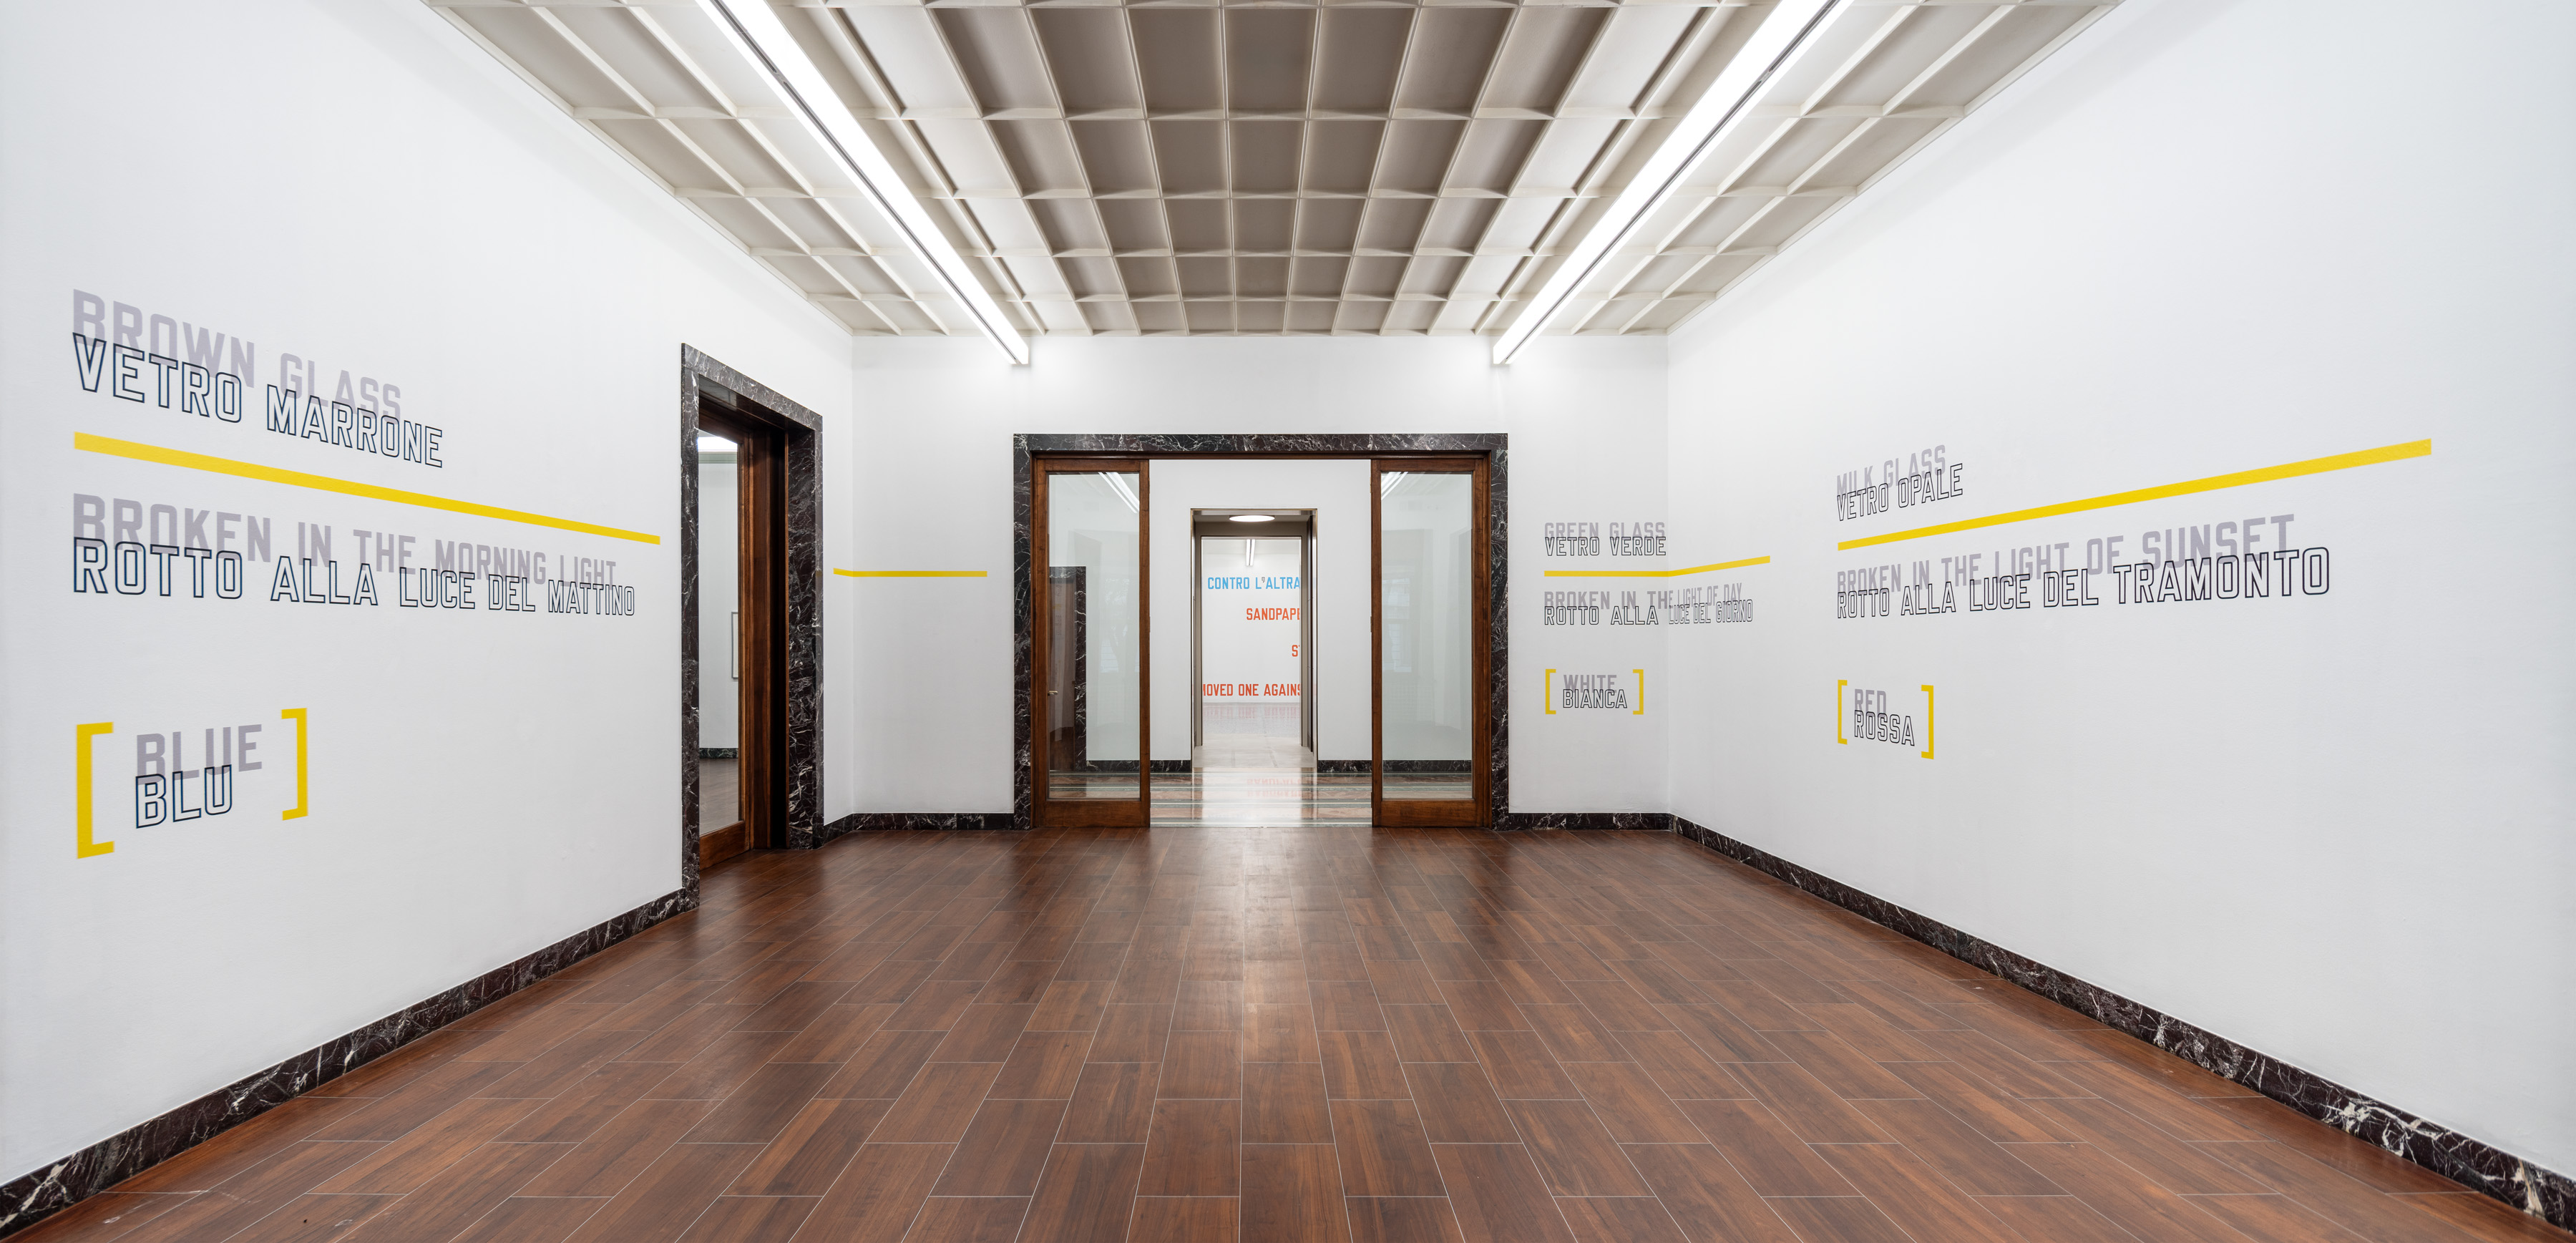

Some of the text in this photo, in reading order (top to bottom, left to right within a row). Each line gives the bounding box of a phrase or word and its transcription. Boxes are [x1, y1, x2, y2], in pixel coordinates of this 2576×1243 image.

[74, 289, 400, 425] BROWN GLASS
[72, 332, 442, 468] VETRO MARRONE
[1837, 444, 1946, 499] MILK GLASS
[1837, 463, 1963, 521] VETRO OPALE
[74, 493, 616, 590] BROKEN IN THE MORNING LIGHT
[1544, 522, 1665, 540] GREEN GLASS
[1545, 537, 1666, 556] VETRO VERDE
[74, 537, 635, 616] ROTTO ALLA LUCE DEL MATTINO
[1838, 514, 2294, 597] BROKEN IN THE LIGHT OF SUNSET
[1208, 577, 1250, 590] CONTRO
[1544, 582, 1742, 609] BROKEN IN THE LIGHT OF DAY
[1838, 547, 2330, 618] ROTTO ALLA LUCE DEL TRAMONTO
[1544, 599, 1752, 625] ROTTO ALLA LUCE DEL GIORNO
[1238, 683, 1259, 696] ONE
[1563, 675, 1617, 693] WHITE
[1563, 689, 1627, 708] BIANCA
[1855, 688, 1886, 718] RED
[1854, 710, 1915, 746] ROSSA
[137, 724, 262, 786] BLUE
[135, 764, 233, 829] BLU
